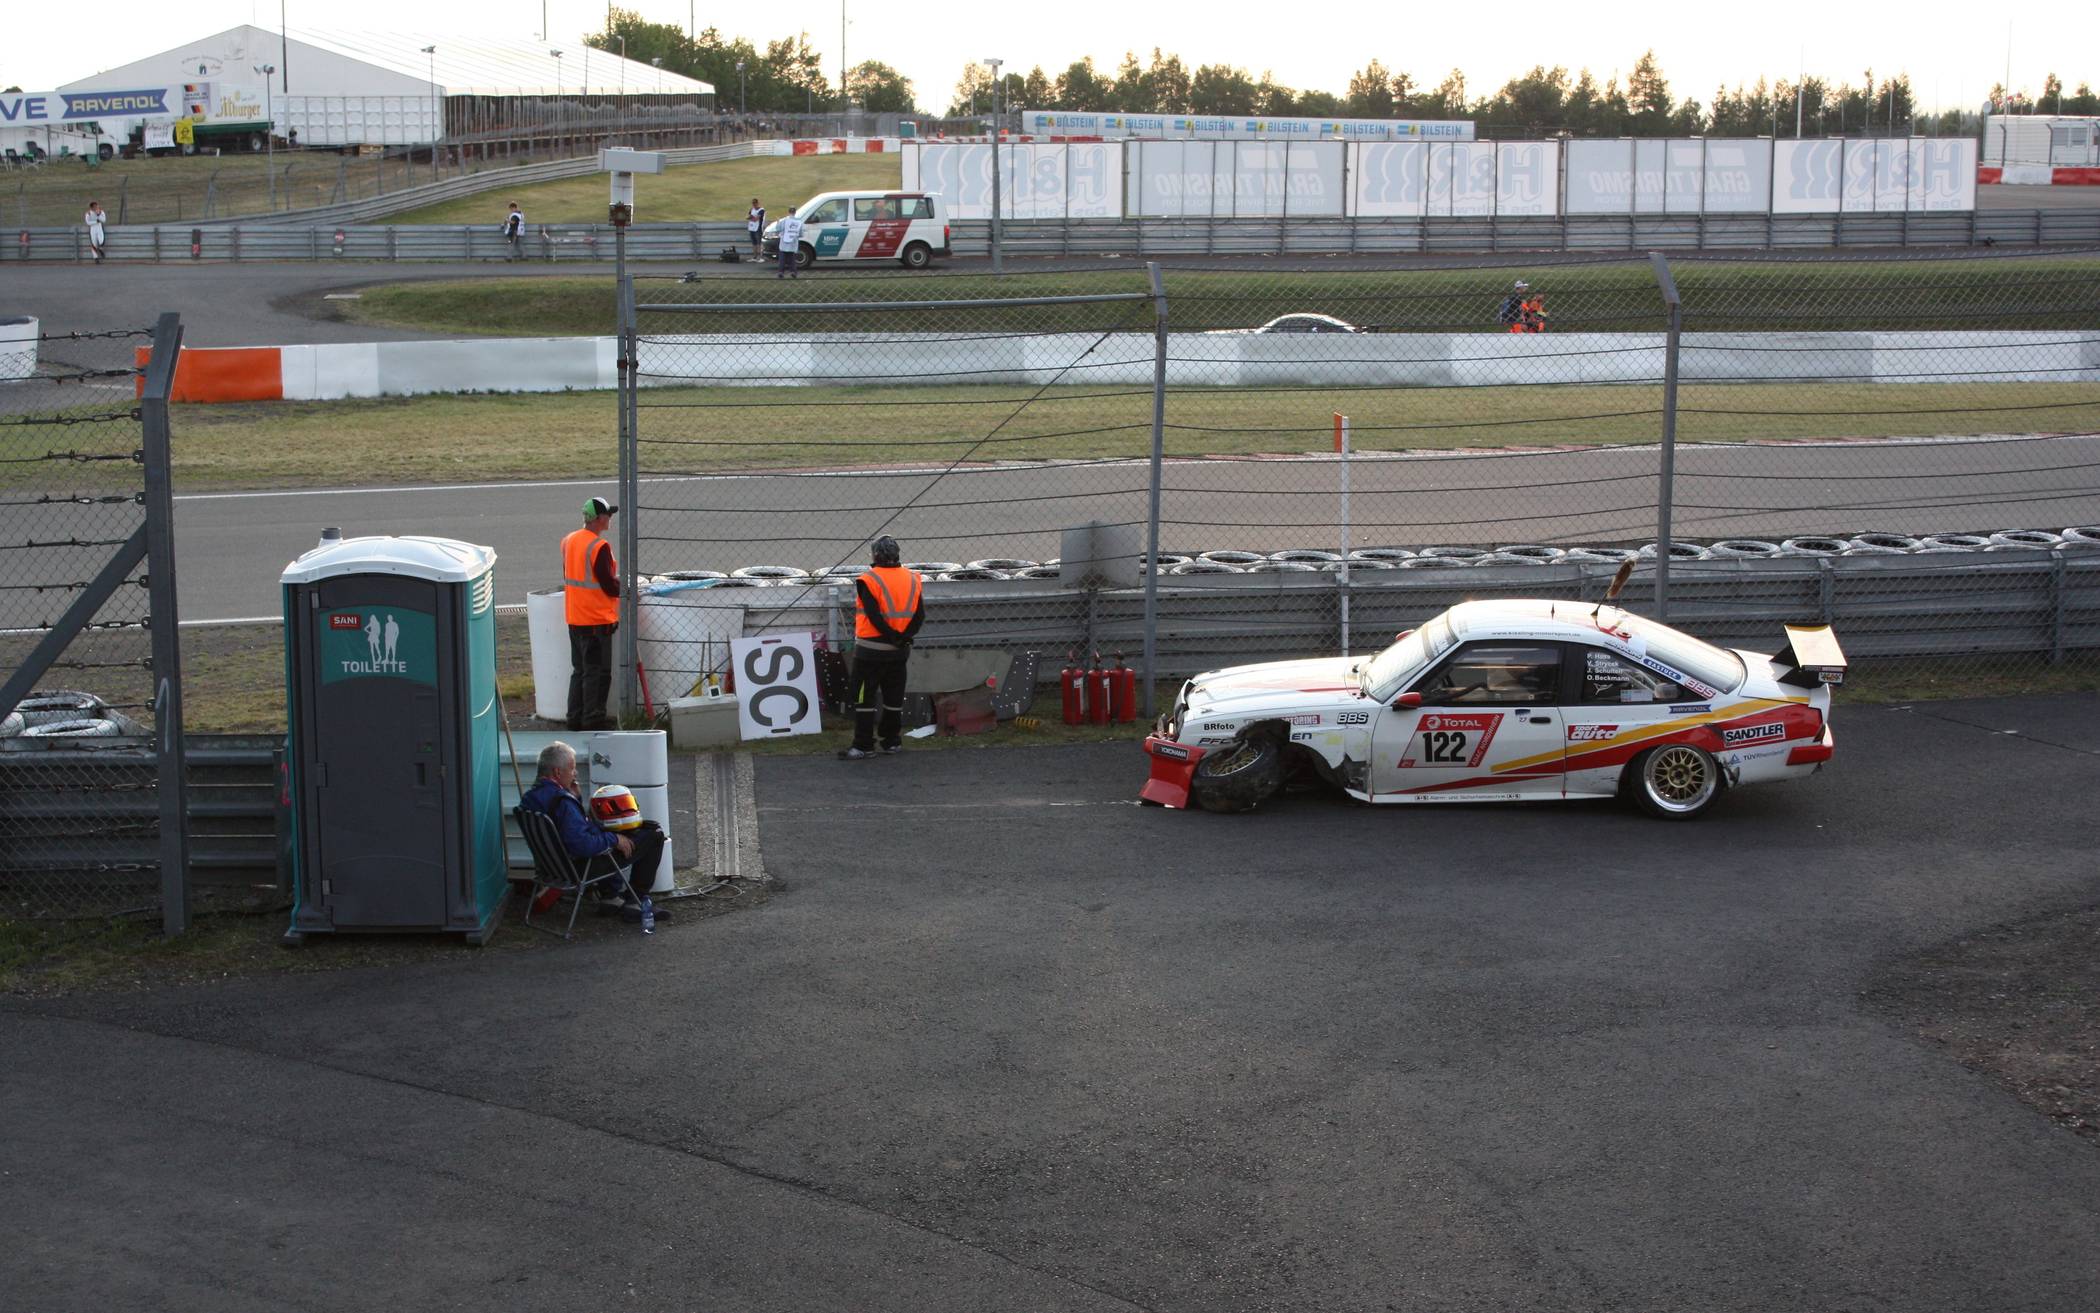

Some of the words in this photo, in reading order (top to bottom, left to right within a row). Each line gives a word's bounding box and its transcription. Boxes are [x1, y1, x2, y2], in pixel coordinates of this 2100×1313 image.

[72, 95, 160, 113] RAVENOL
[1056, 116, 1095, 128] BILSTEIN
[1125, 118, 1164, 129] BILSTEIN
[1195, 119, 1234, 131] BILSTEIN
[1268, 121, 1308, 133] BILSTEIN
[1343, 122, 1386, 134] BILSTEIN
[1420, 124, 1462, 136] BILSTEIN
[334, 616, 358, 624] SANI
[341, 661, 407, 673] TOILETTE
[744, 645, 809, 727] SC
[1685, 678, 1717, 700] BBS
[1337, 712, 1369, 724] BBS
[1442, 718, 1482, 727] TOTAL
[1204, 722, 1235, 731] BRfoto
[1725, 723, 1784, 741] SANDTLER
[1571, 729, 1617, 740] auto
[1422, 731, 1467, 762] 122
